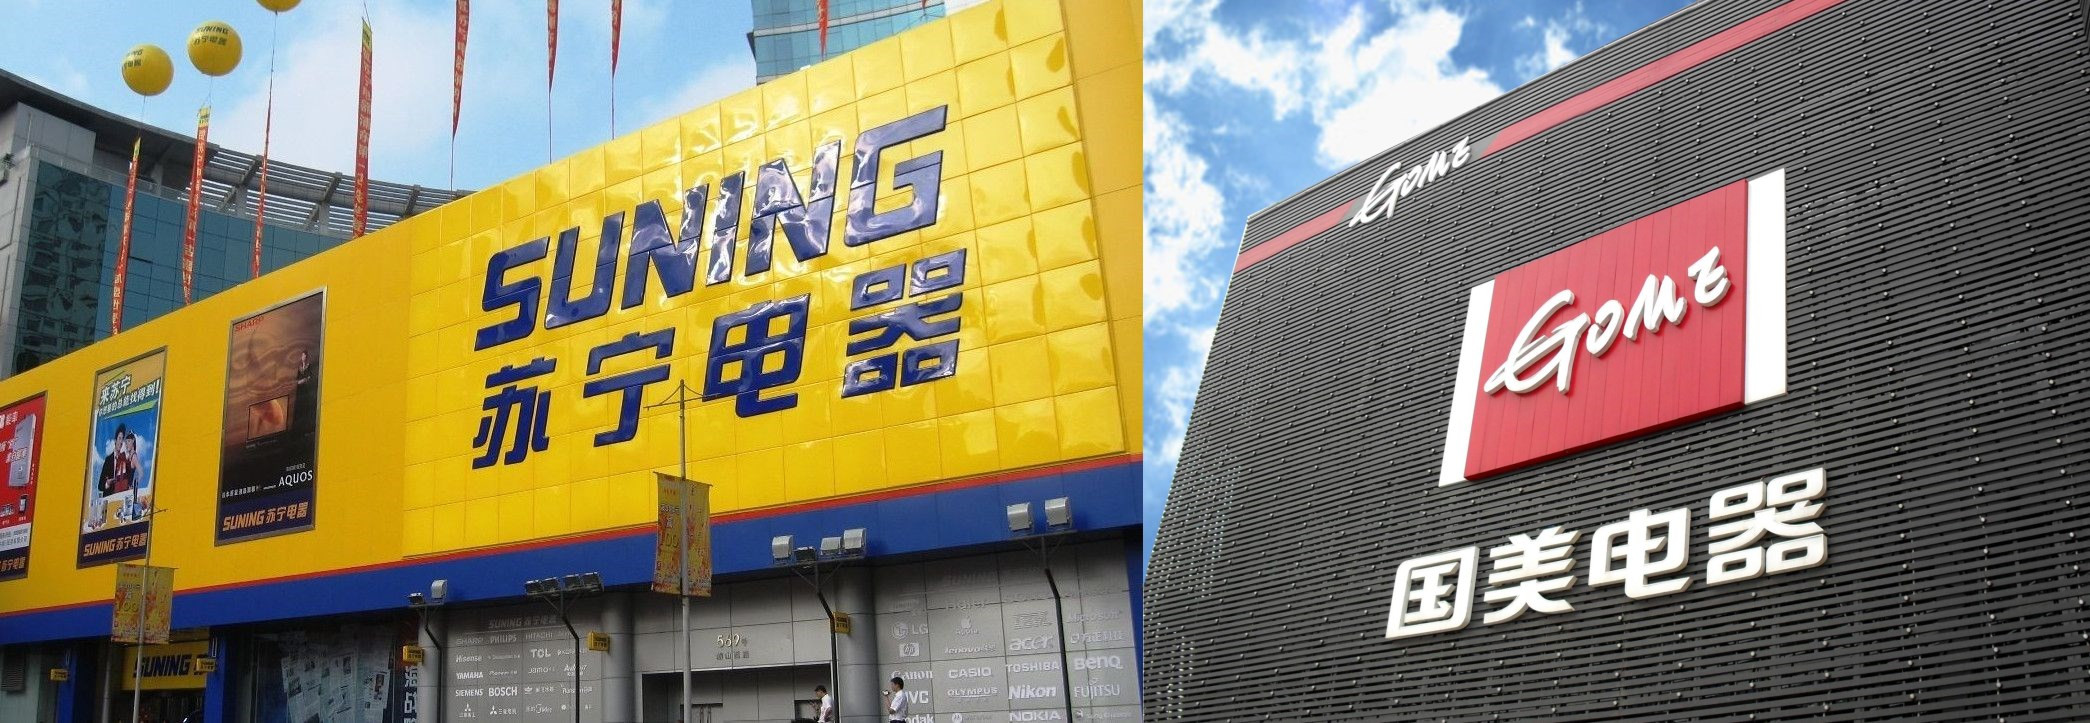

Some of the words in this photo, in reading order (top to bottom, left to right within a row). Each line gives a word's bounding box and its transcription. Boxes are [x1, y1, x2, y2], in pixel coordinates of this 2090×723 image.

[474, 104, 948, 351] SUNING
[471, 248, 967, 470] 苏宁电器
[99, 375, 131, 406] 来苏宁
[278, 469, 313, 487] AQUOS
[222, 509, 266, 531] SUNING
[266, 501, 309, 524] 苏宁电器
[83, 538, 116, 558] SUNING
[115, 532, 148, 551] 苏宁电器
[1384, 467, 1828, 639] 国美电器
[912, 624, 929, 634] LG
[490, 634, 517, 644] PHILIPS
[1009, 635, 1054, 651] acer
[455, 655, 482, 663] Hisense
[530, 648, 551, 659] TCL
[133, 654, 192, 678] SUNING
[1005, 661, 1060, 673] TOSHIBA
[1074, 655, 1124, 670] BenQ
[456, 671, 484, 680] YAMAHA
[948, 667, 992, 679] CASIO
[455, 688, 484, 697] SIEMENS
[488, 686, 518, 697] BOSCH
[947, 687, 998, 697] OLYMPUS
[1008, 684, 1057, 700] Nikon
[1074, 683, 1121, 699] FUJITSU
[1009, 710, 1062, 722] NOKIA
